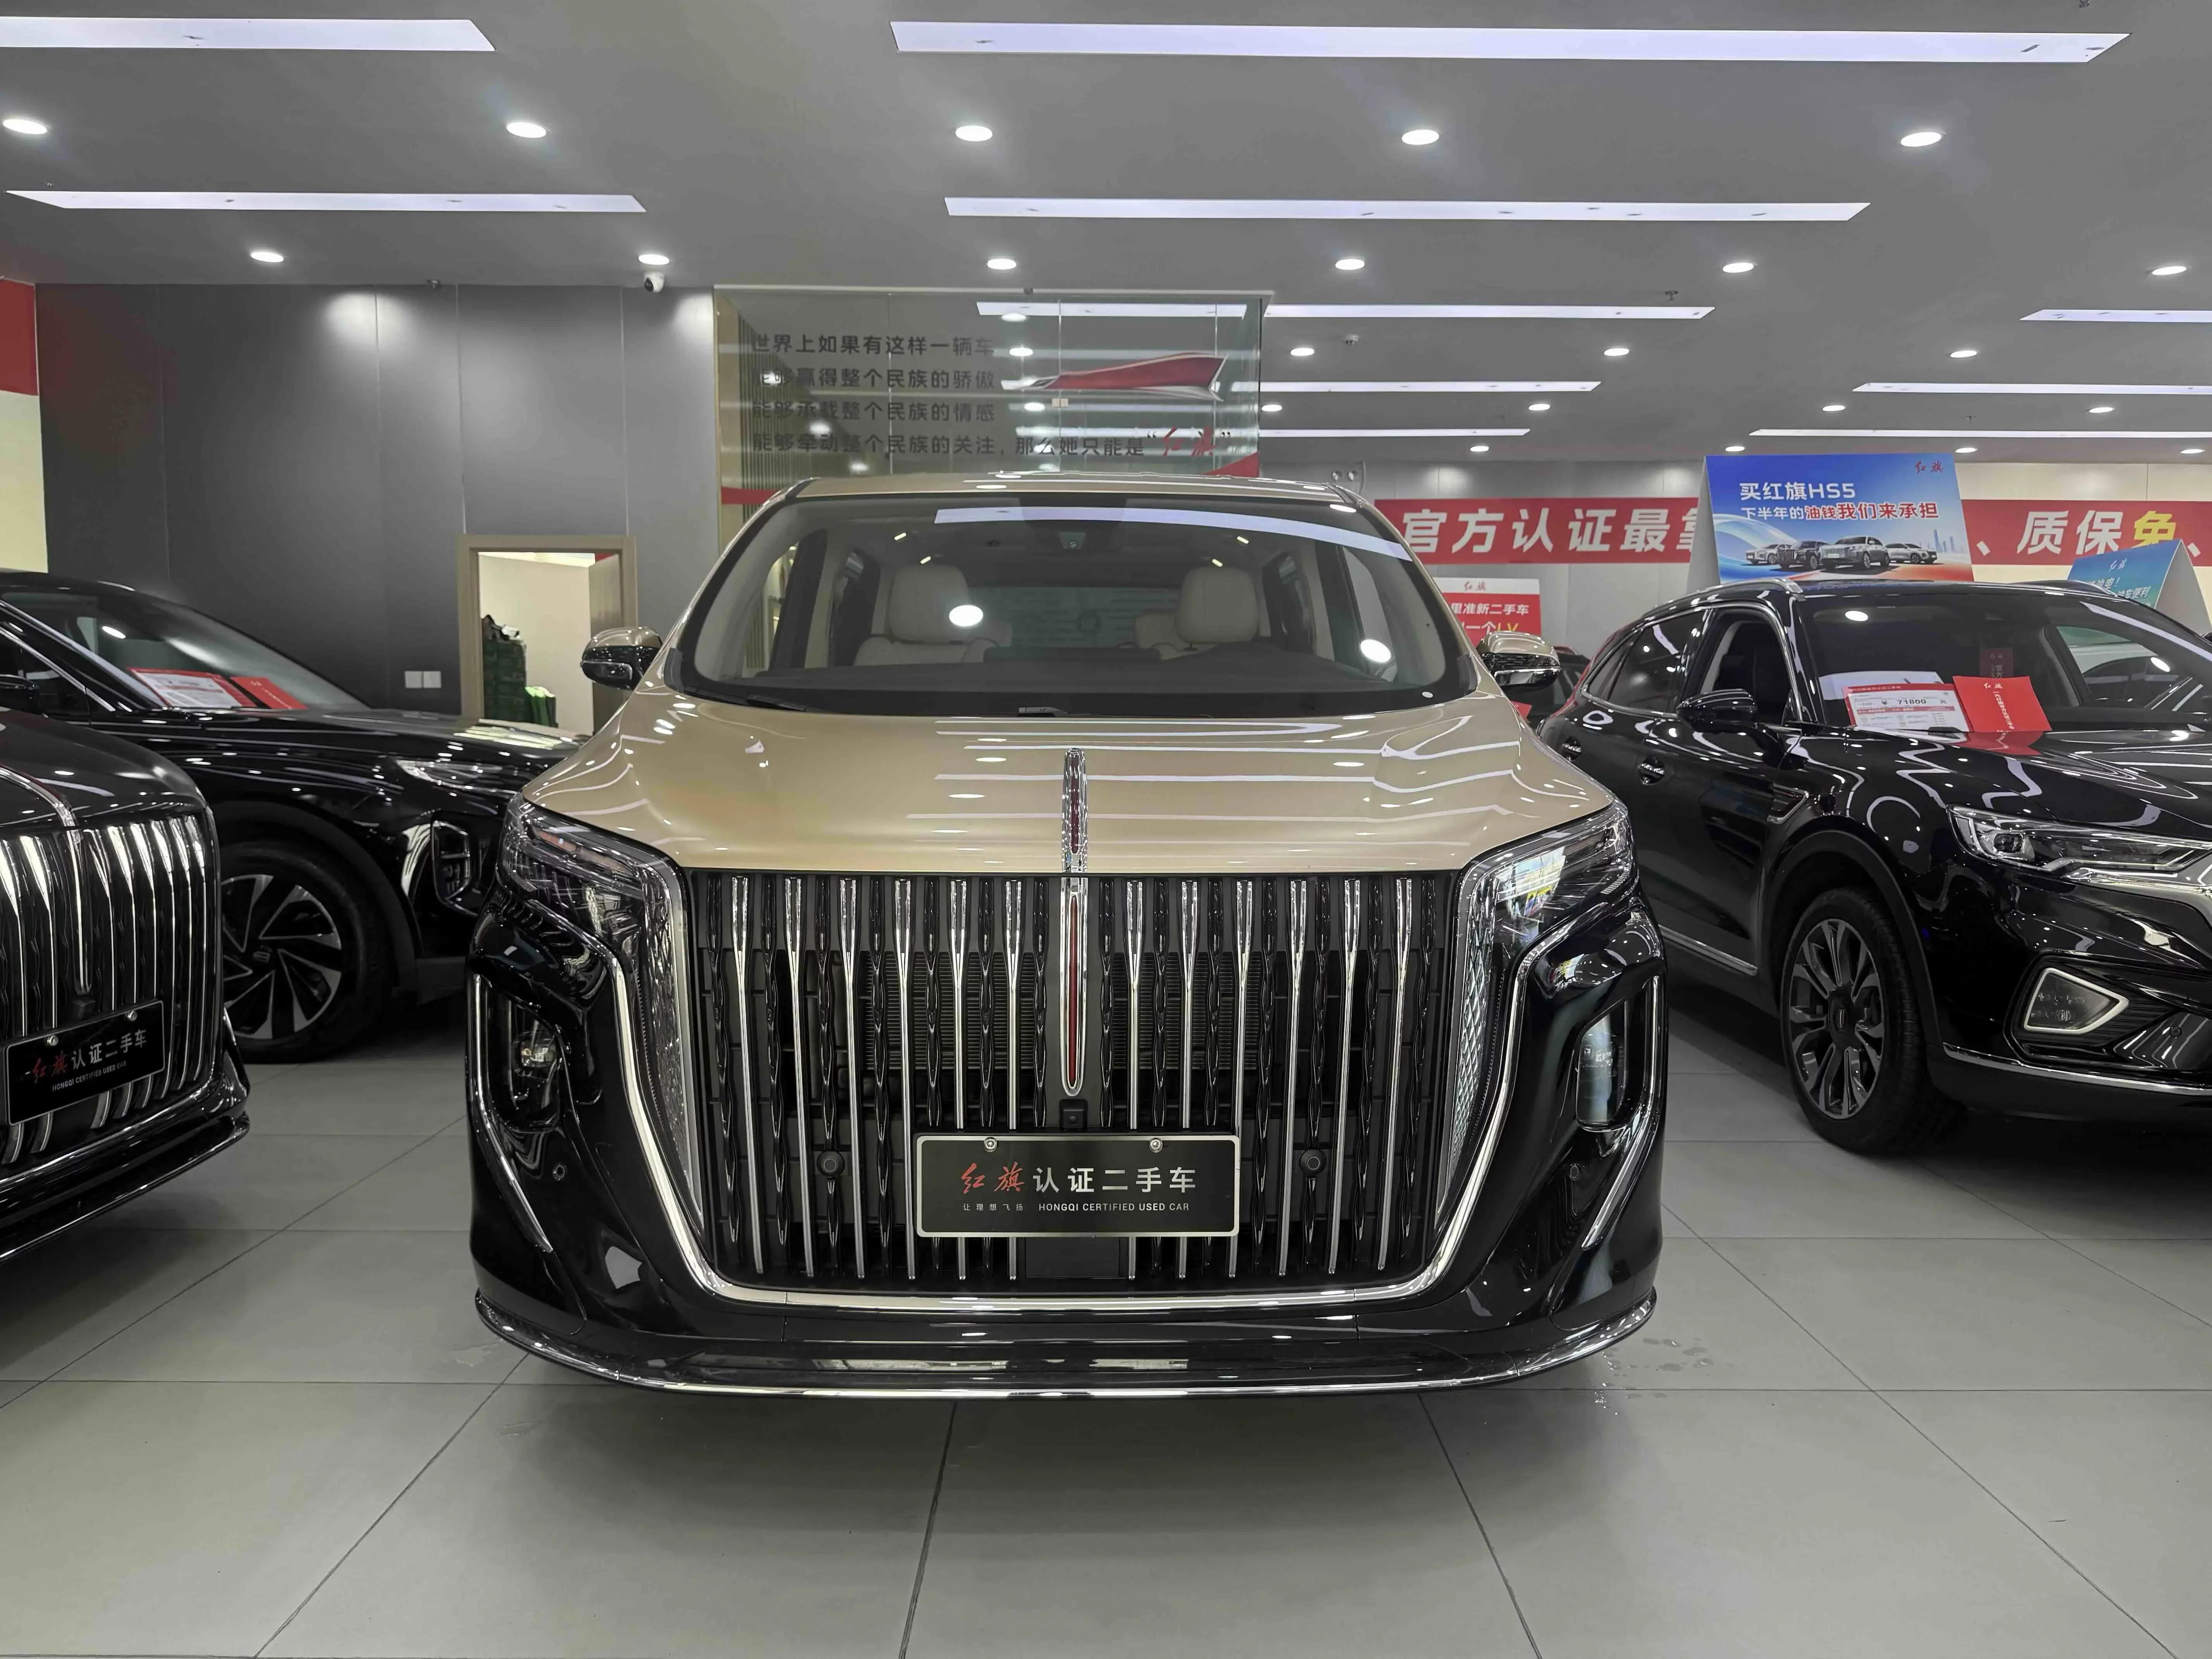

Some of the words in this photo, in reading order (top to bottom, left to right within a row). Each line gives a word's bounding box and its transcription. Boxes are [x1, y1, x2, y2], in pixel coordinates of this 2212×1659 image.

[752, 334, 994, 356] 世界上如果有这样一辆车
[1739, 483, 1856, 501] 买红旗HS5
[1741, 502, 1939, 520] 下半年的油钱我们来承担
[52, 1078, 74, 1091] HONGQI
[76, 1070, 102, 1084] CERTIFIED
[103, 1065, 116, 1074] USED
[963, 1203, 1023, 1211] 让理想飞扬
[1038, 1203, 1079, 1212] HONGQI
[1082, 1203, 1135, 1211] CERTIFIED
[1139, 1203, 1165, 1211] USED
[1169, 1203, 1189, 1211] CAR
